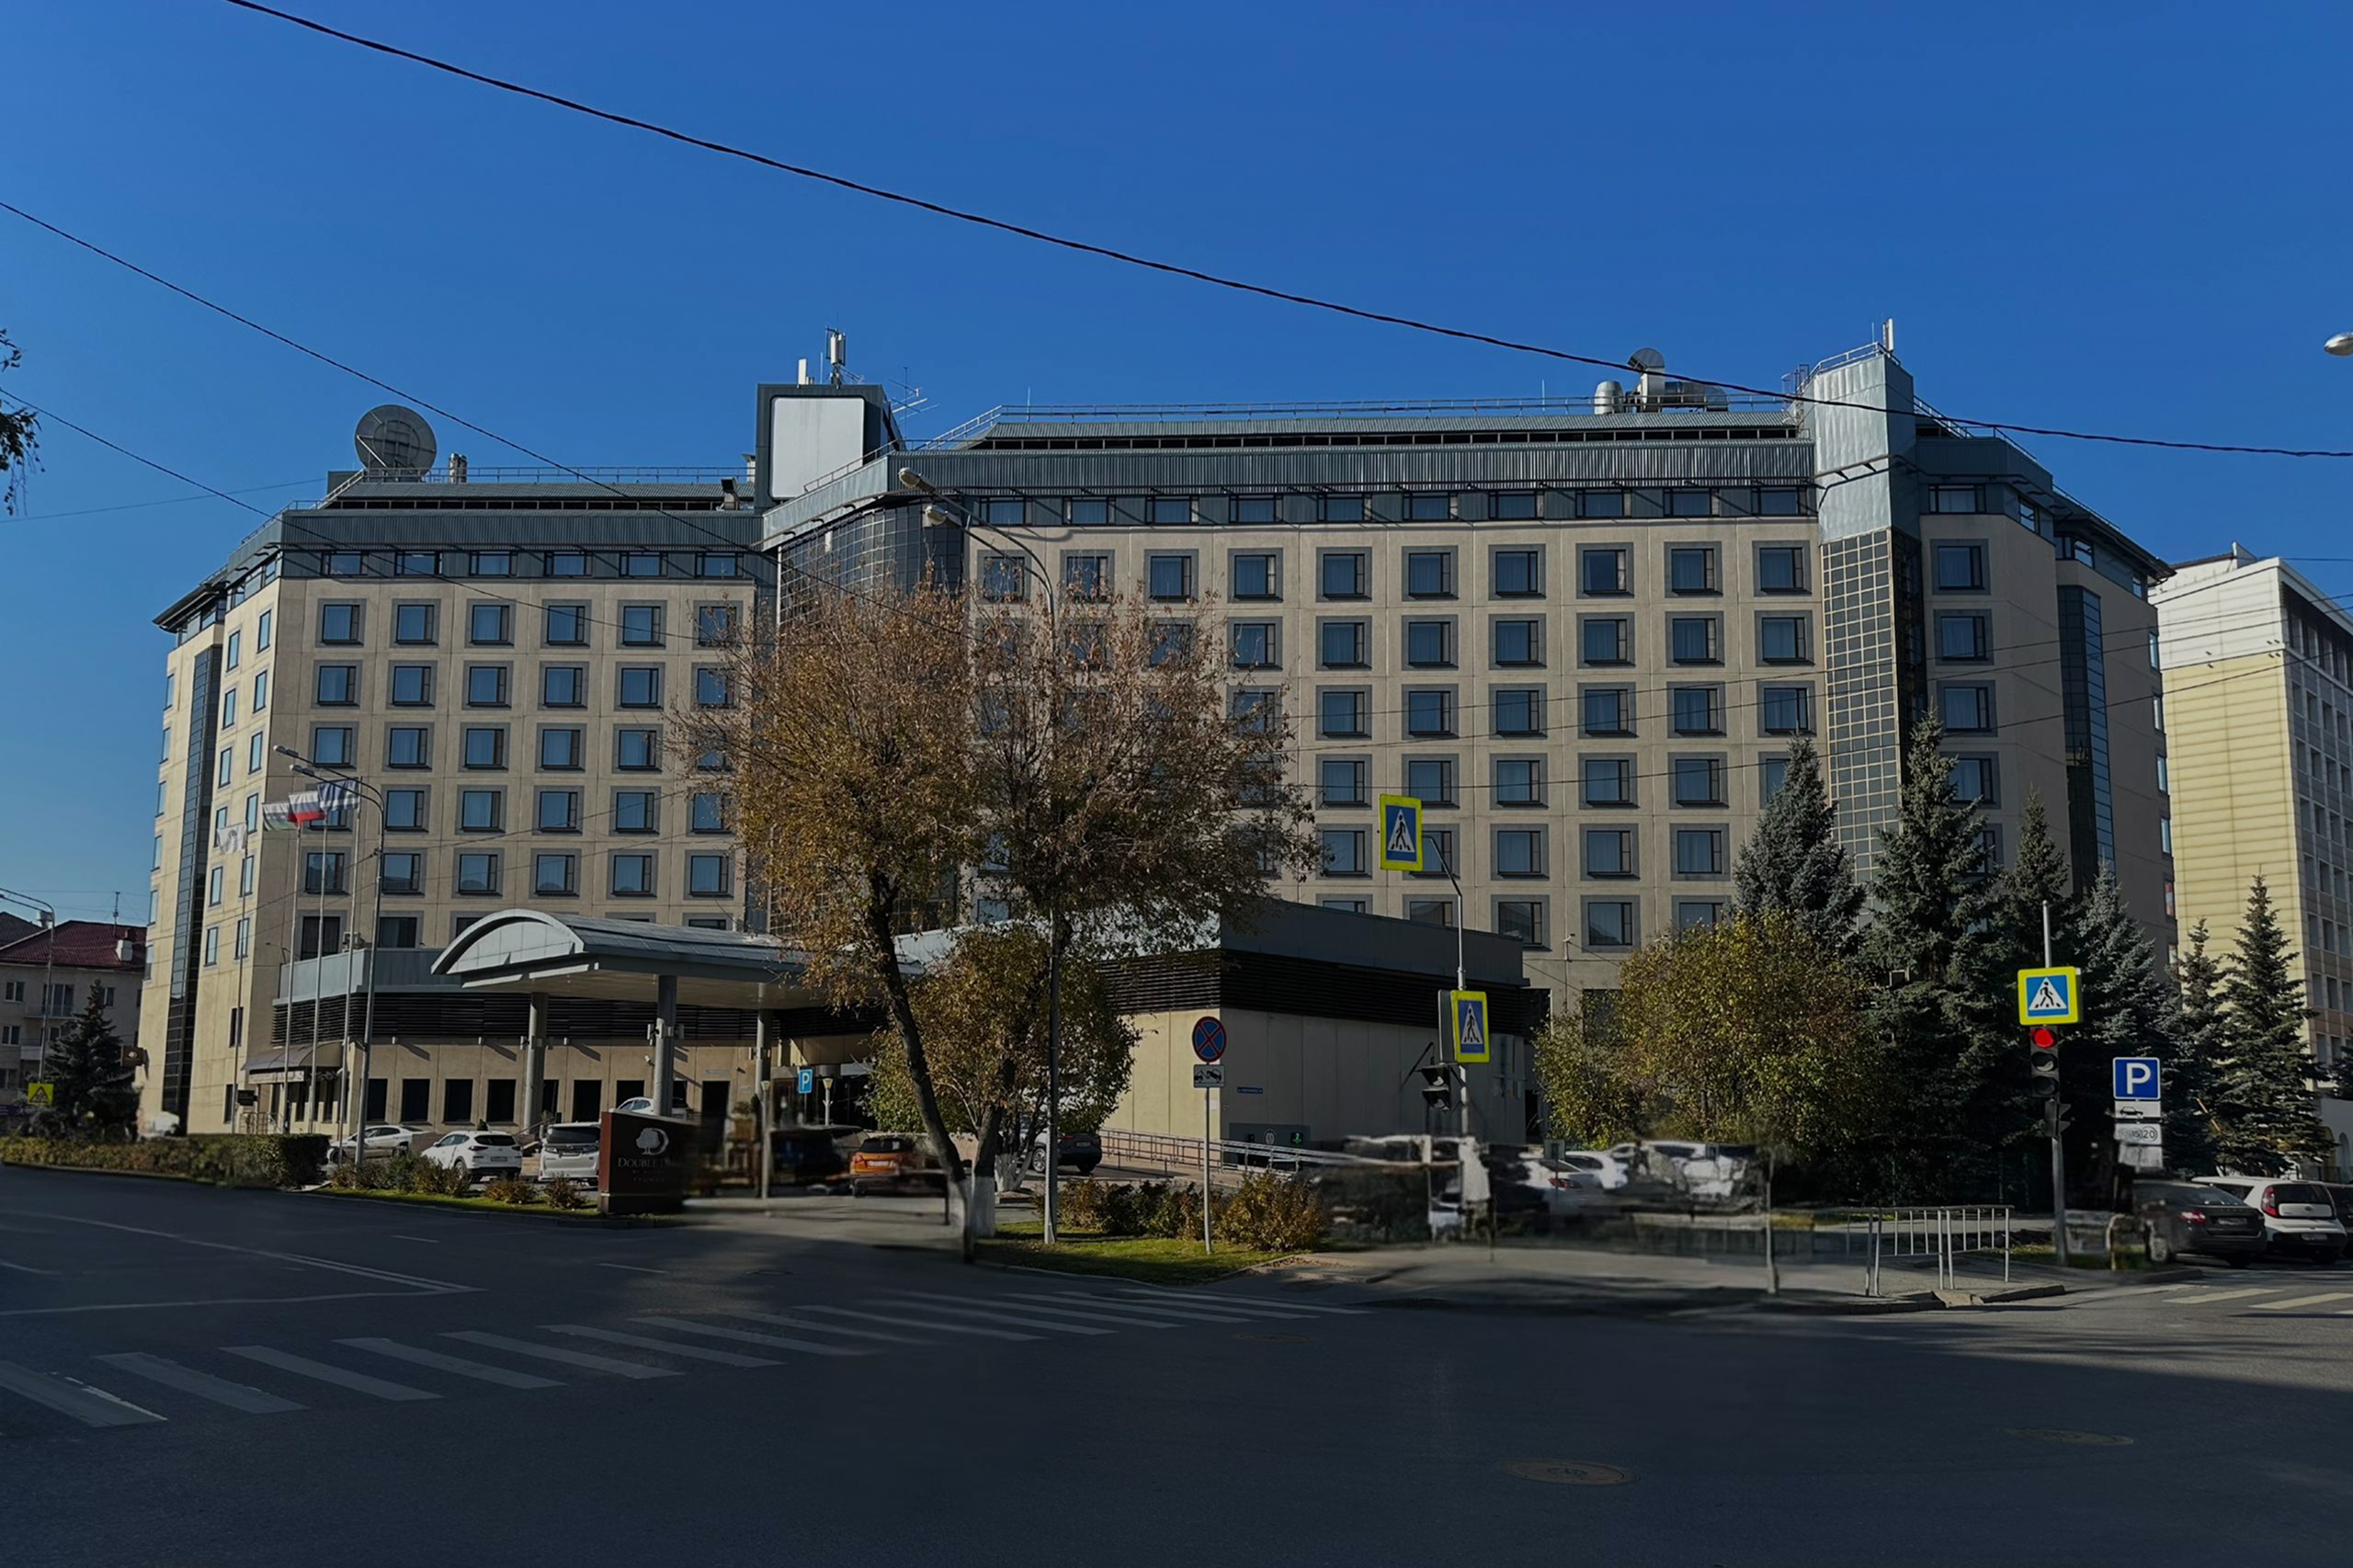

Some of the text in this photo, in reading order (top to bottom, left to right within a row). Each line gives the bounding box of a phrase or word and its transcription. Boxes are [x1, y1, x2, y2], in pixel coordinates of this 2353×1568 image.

[801, 1072, 810, 1091] P
[2126, 1062, 2152, 1095] P
[2143, 1130, 2155, 1139] 20
